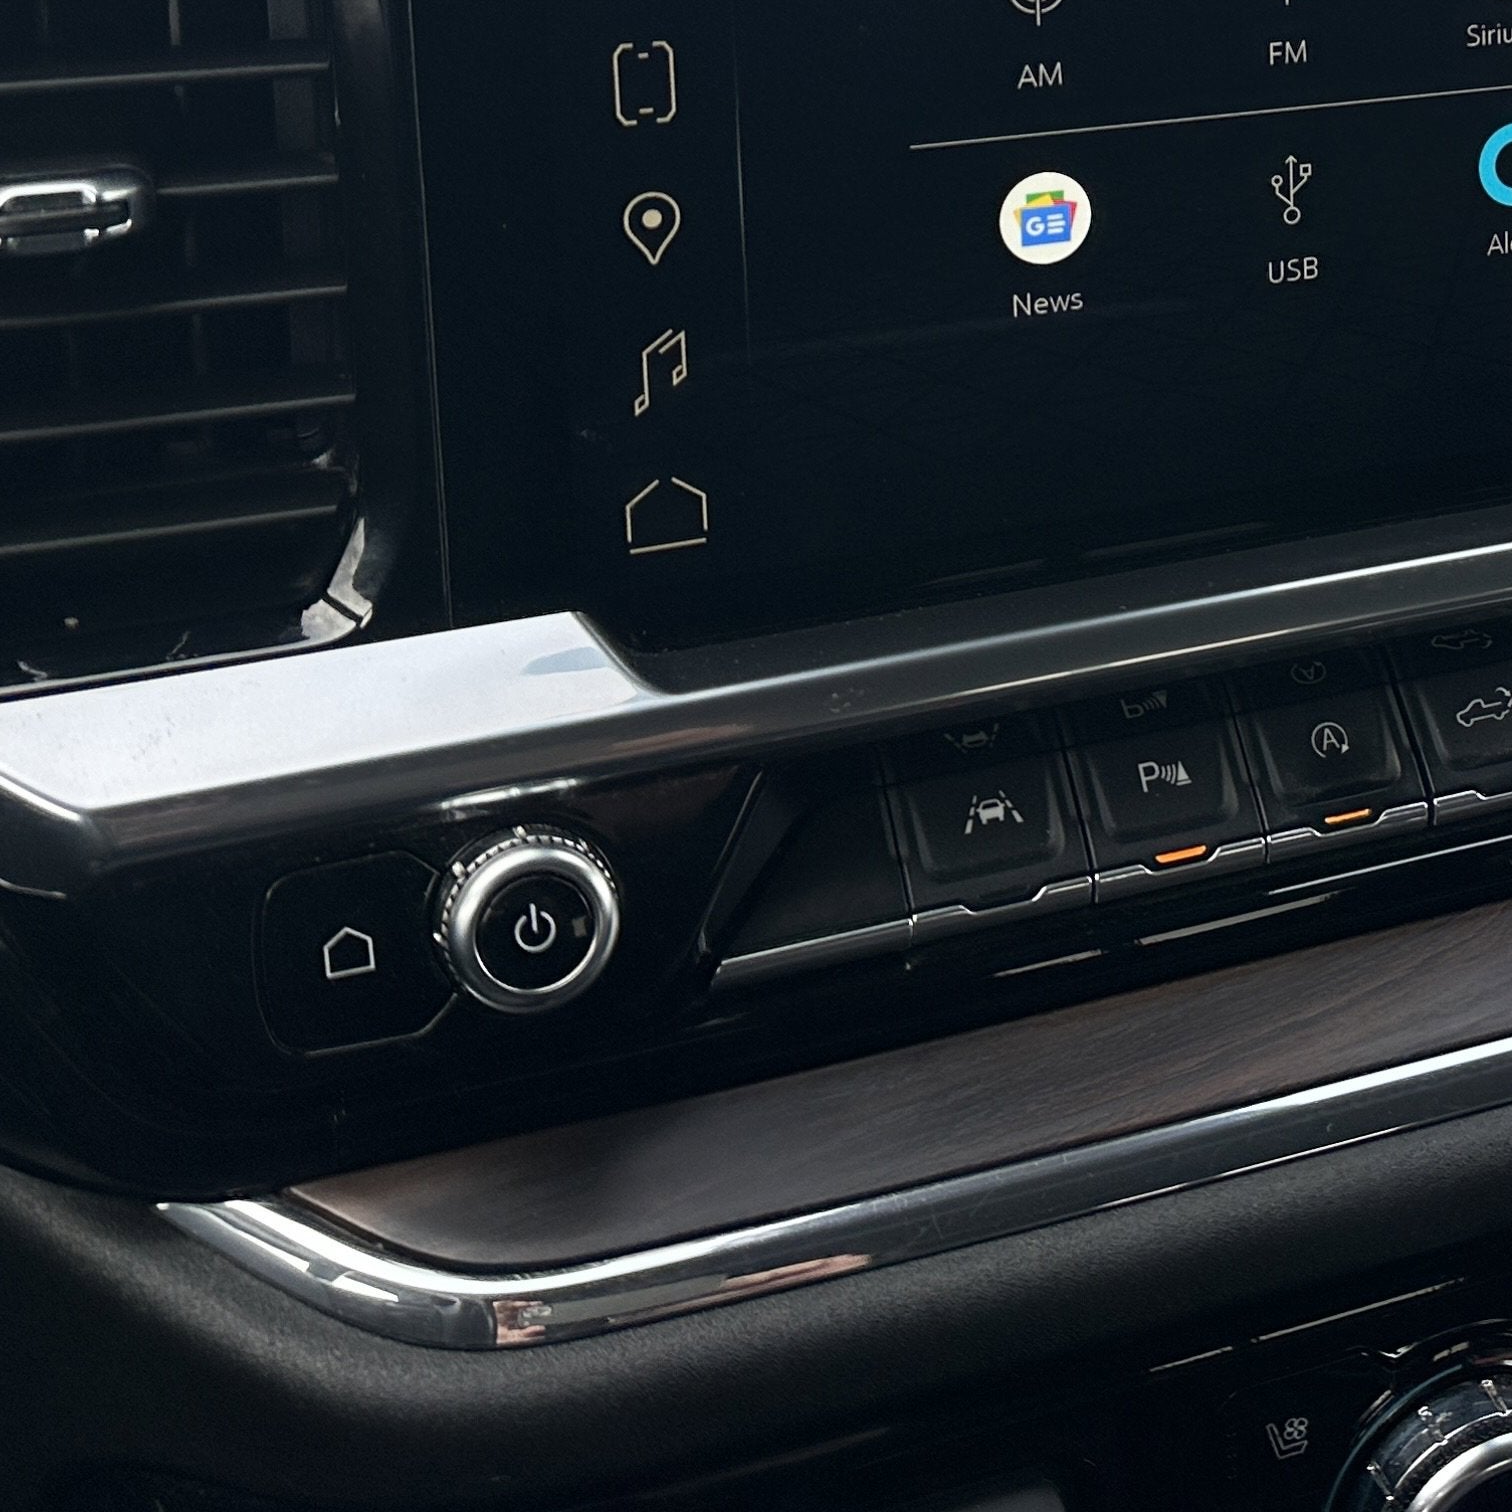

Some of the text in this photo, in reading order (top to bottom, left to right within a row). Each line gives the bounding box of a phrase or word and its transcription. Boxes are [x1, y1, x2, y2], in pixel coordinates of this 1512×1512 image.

[1270, 40, 1307, 65] FM
[1018, 62, 1063, 89] AM
[1269, 257, 1318, 284] USB
[1013, 291, 1083, 318] News
[1138, 761, 1157, 792] P
